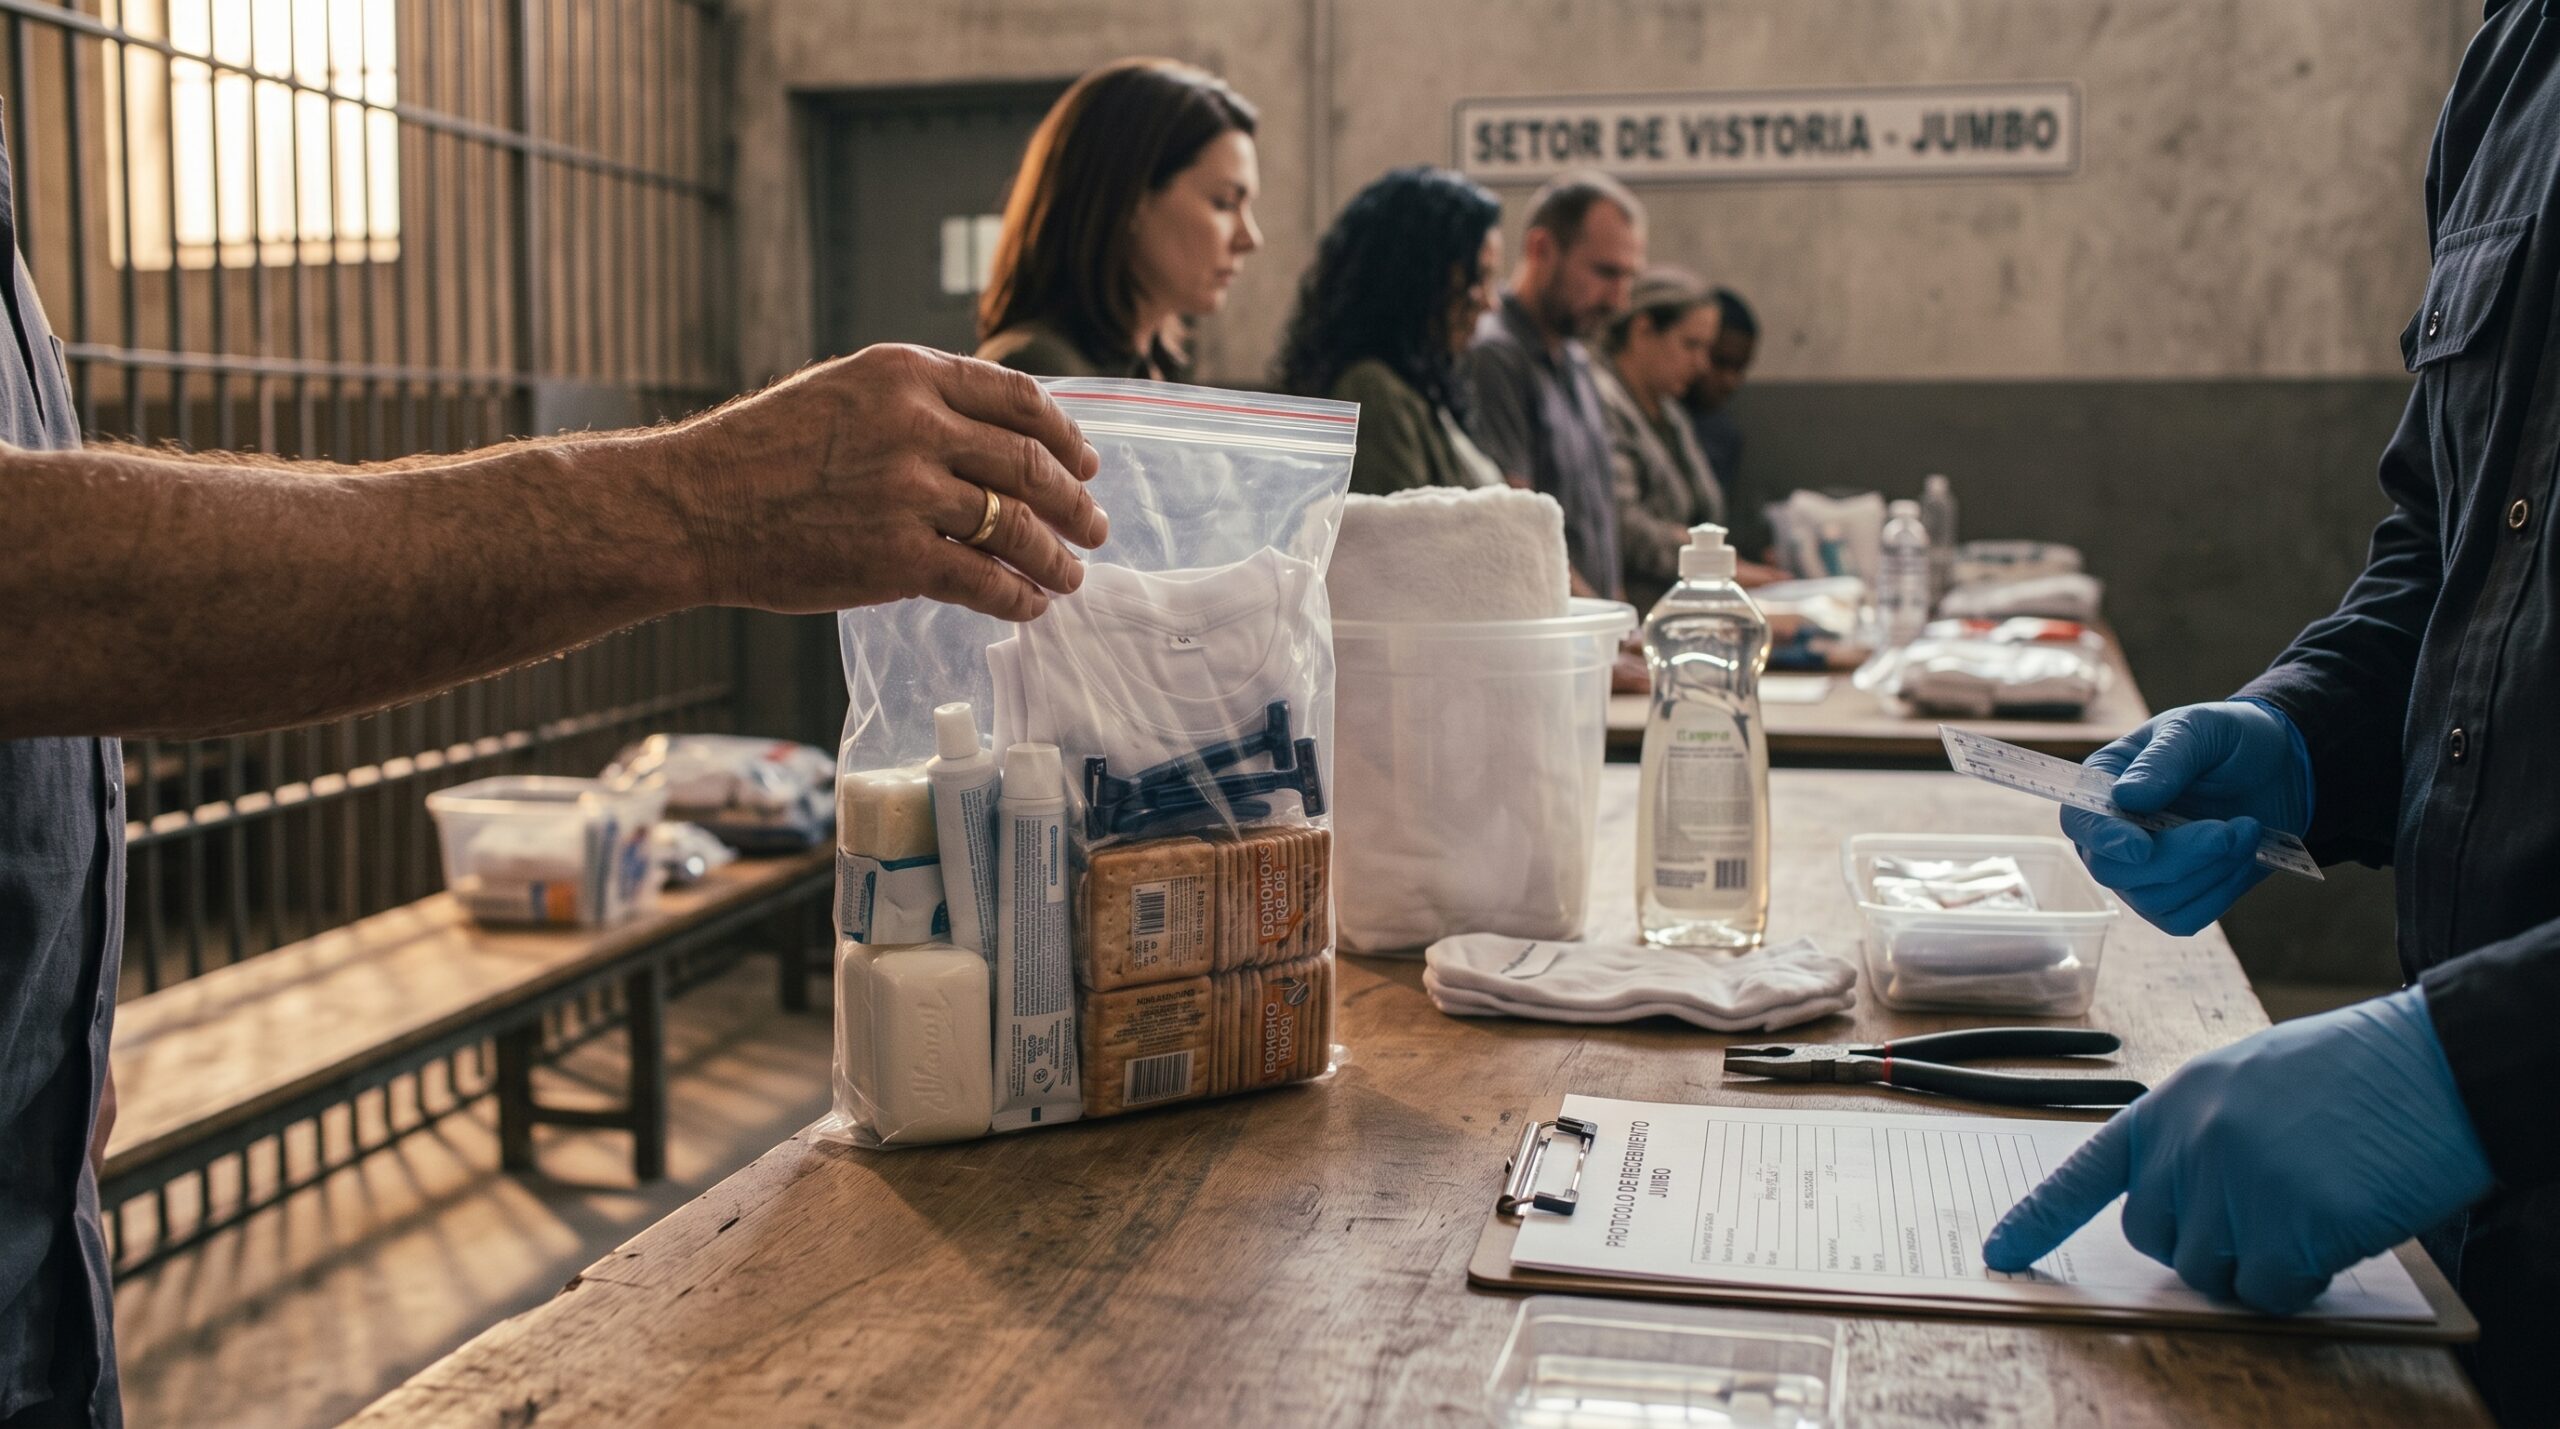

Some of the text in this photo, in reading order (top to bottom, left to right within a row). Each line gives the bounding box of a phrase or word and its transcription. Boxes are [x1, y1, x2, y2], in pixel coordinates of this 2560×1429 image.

[1474, 118, 1603, 164] SETOR
[1615, 116, 1665, 161] DE
[1680, 112, 1871, 159] VISTORIA
[1910, 108, 2059, 155] JUMBO
[1618, 1180, 1638, 1193] DE
[1648, 1168, 1672, 1198] JUMBO
